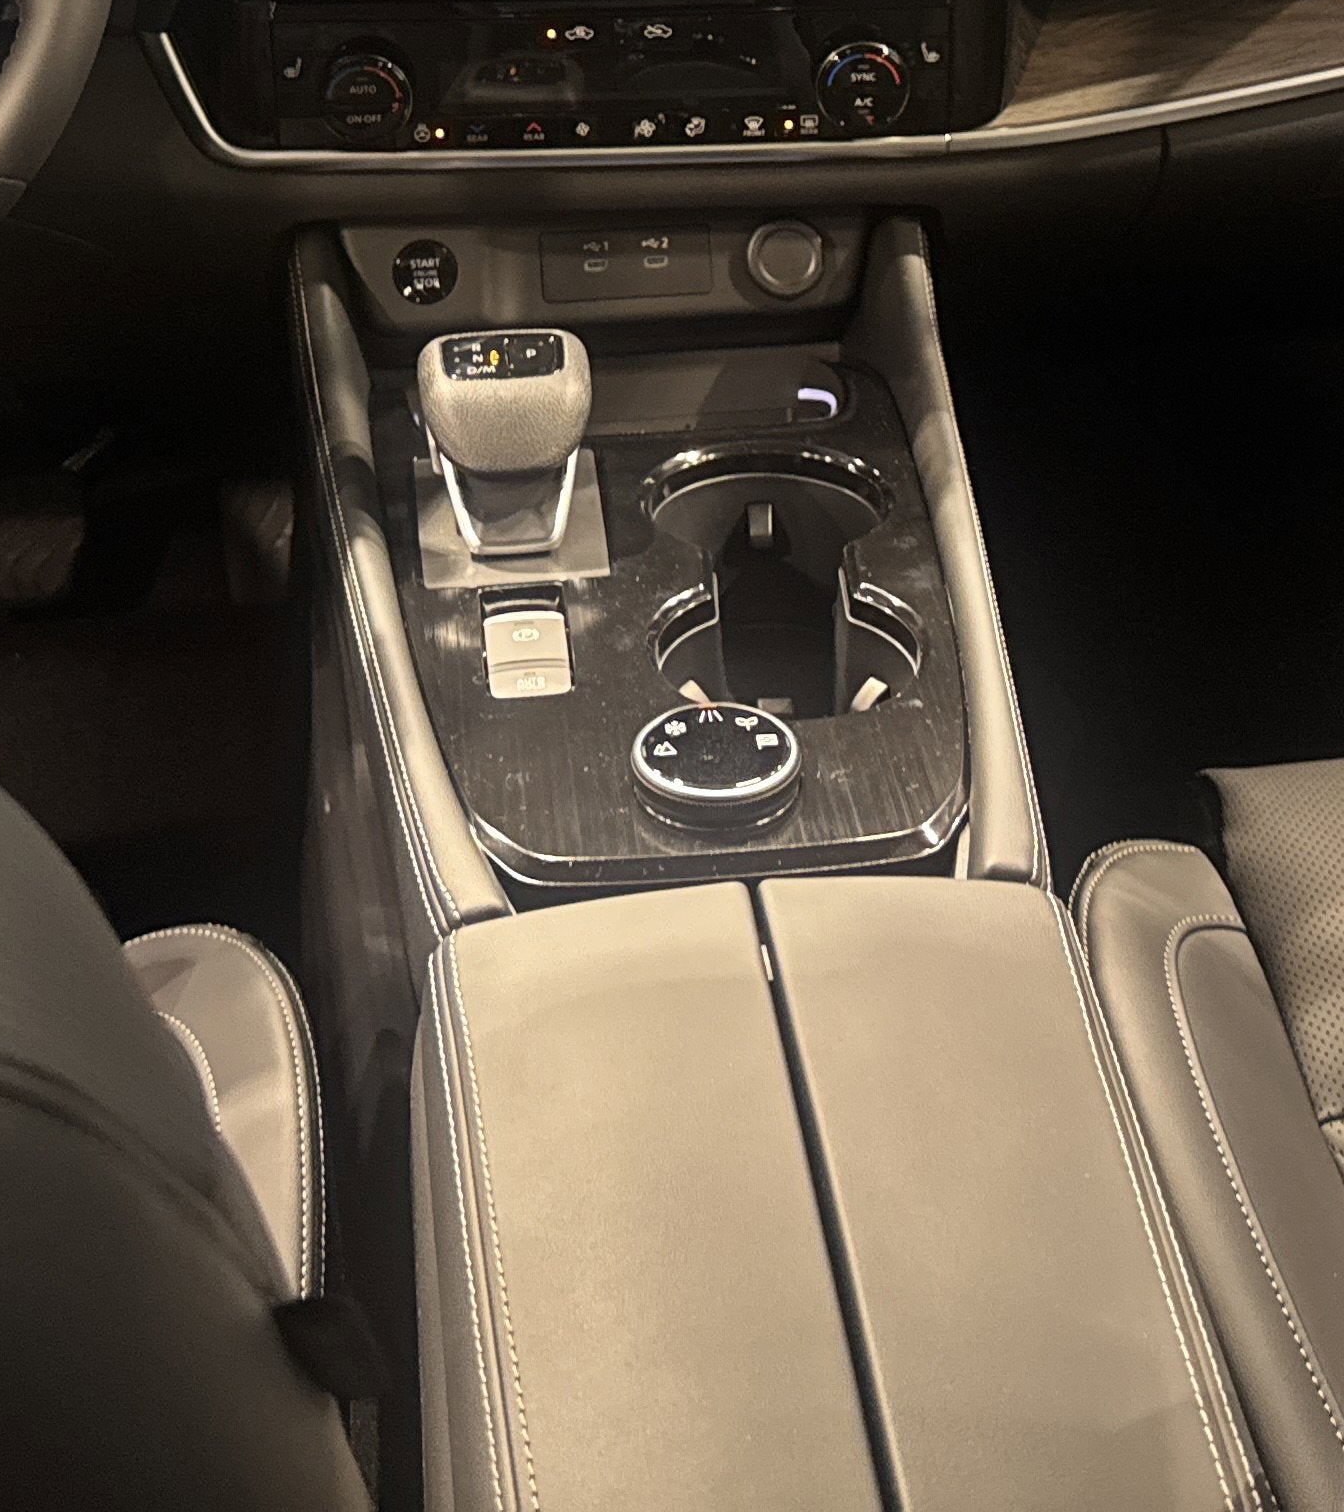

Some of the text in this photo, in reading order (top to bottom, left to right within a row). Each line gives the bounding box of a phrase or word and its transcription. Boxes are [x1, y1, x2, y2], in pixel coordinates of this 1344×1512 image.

[850, 72, 877, 83] SYNC
[349, 84, 377, 96] AUTO
[854, 96, 874, 108] A/C
[660, 237, 669, 249] 2
[409, 256, 441, 269] START
[413, 276, 441, 288] STOP
[472, 353, 484, 364] N
[525, 347, 537, 359] P
[466, 364, 497, 376] D/M
